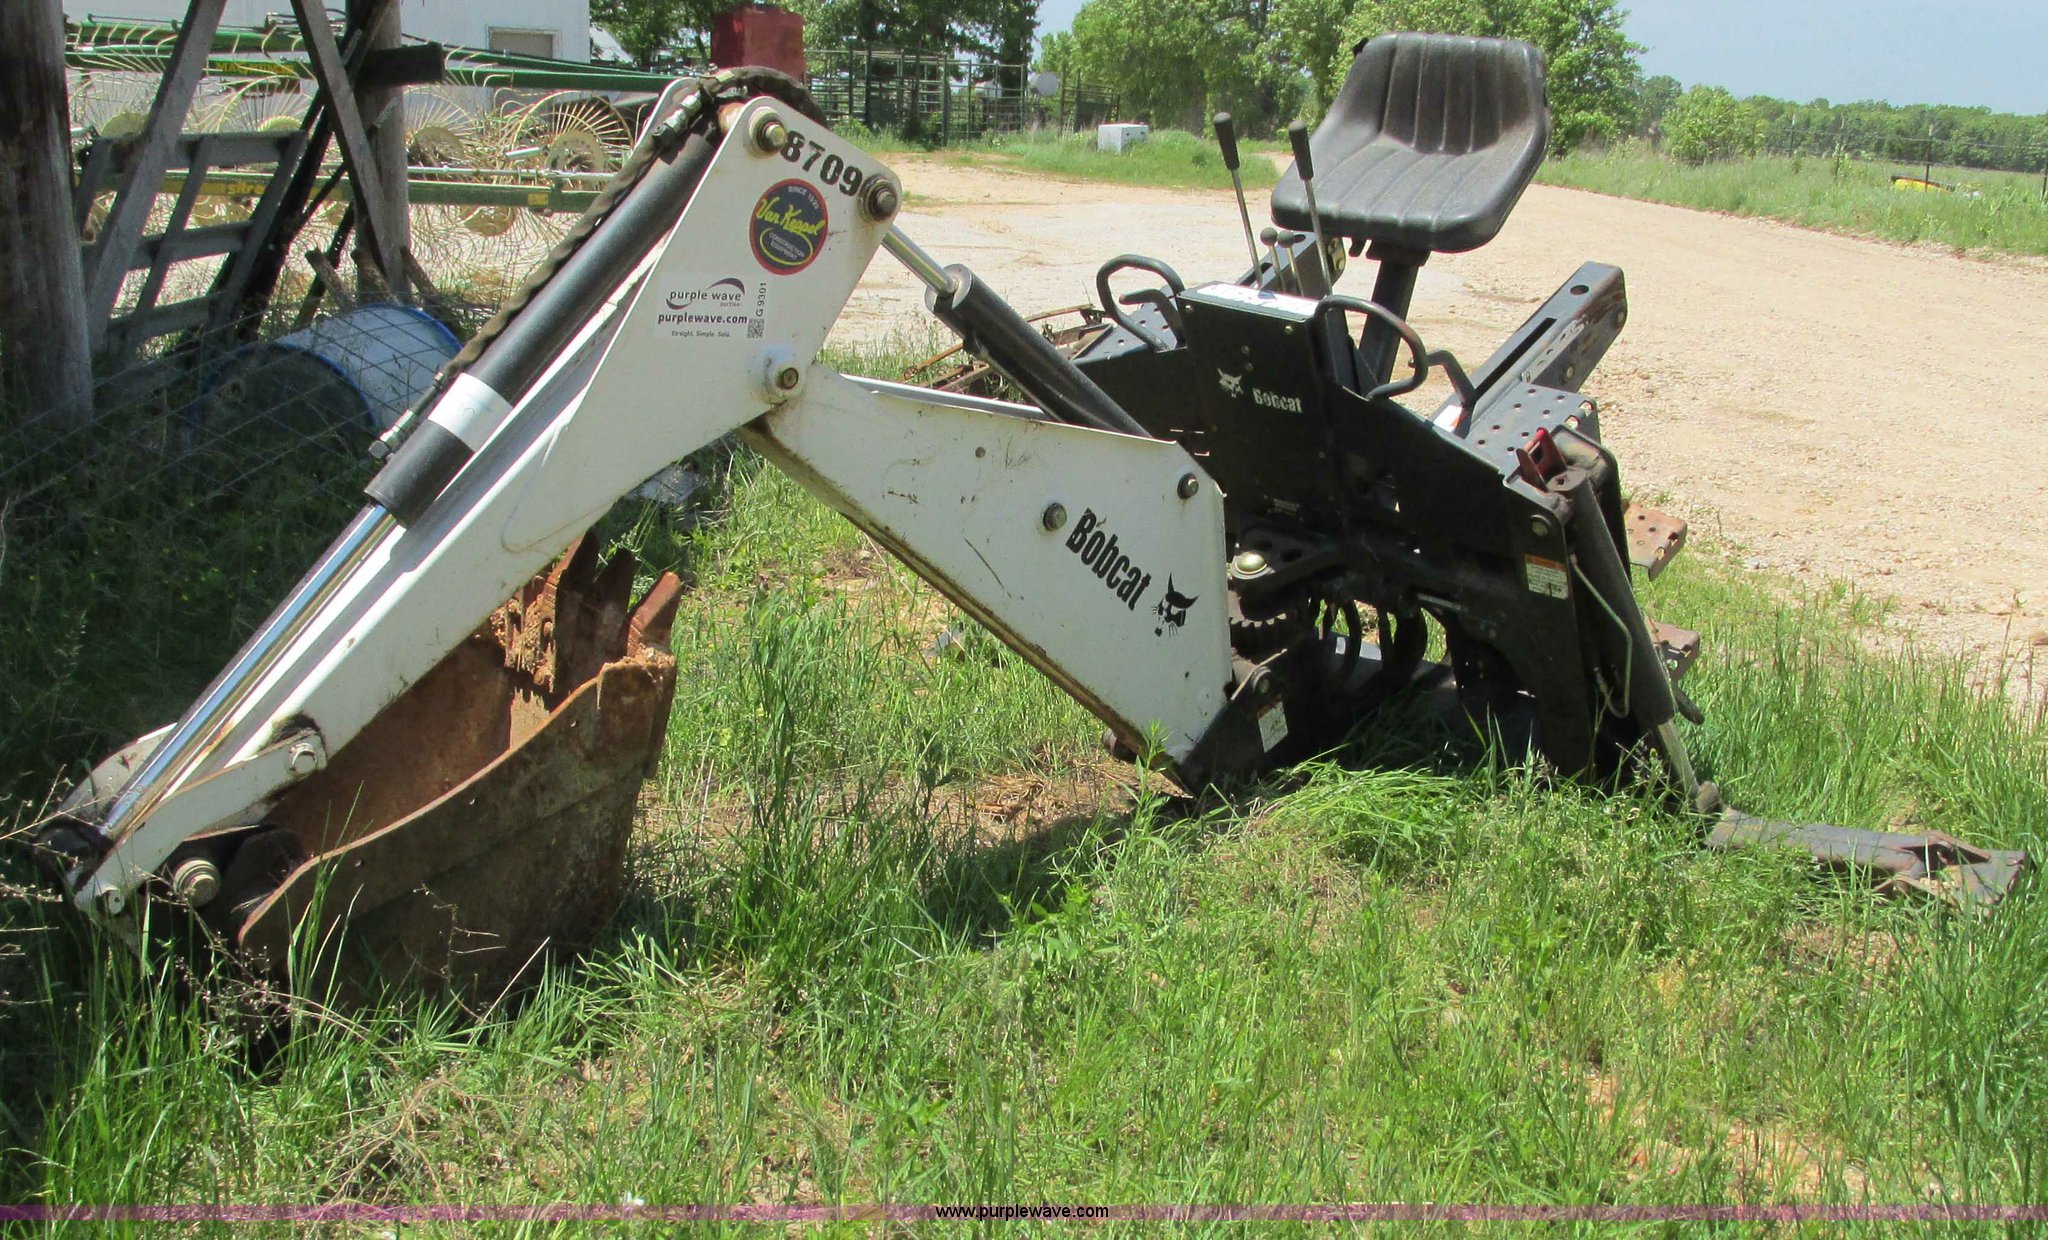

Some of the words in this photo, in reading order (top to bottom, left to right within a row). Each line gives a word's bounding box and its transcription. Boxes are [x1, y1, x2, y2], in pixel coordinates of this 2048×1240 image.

[781, 131, 863, 196] 8709
[756, 196, 780, 224] Van
[669, 290, 708, 302] purple
[711, 291, 741, 301] wave
[757, 282, 767, 307] 9301
[658, 312, 748, 325] purplewave.com
[755, 309, 764, 317] G
[1252, 388, 1303, 413] Bobcat
[1065, 507, 1152, 612] Bobcat
